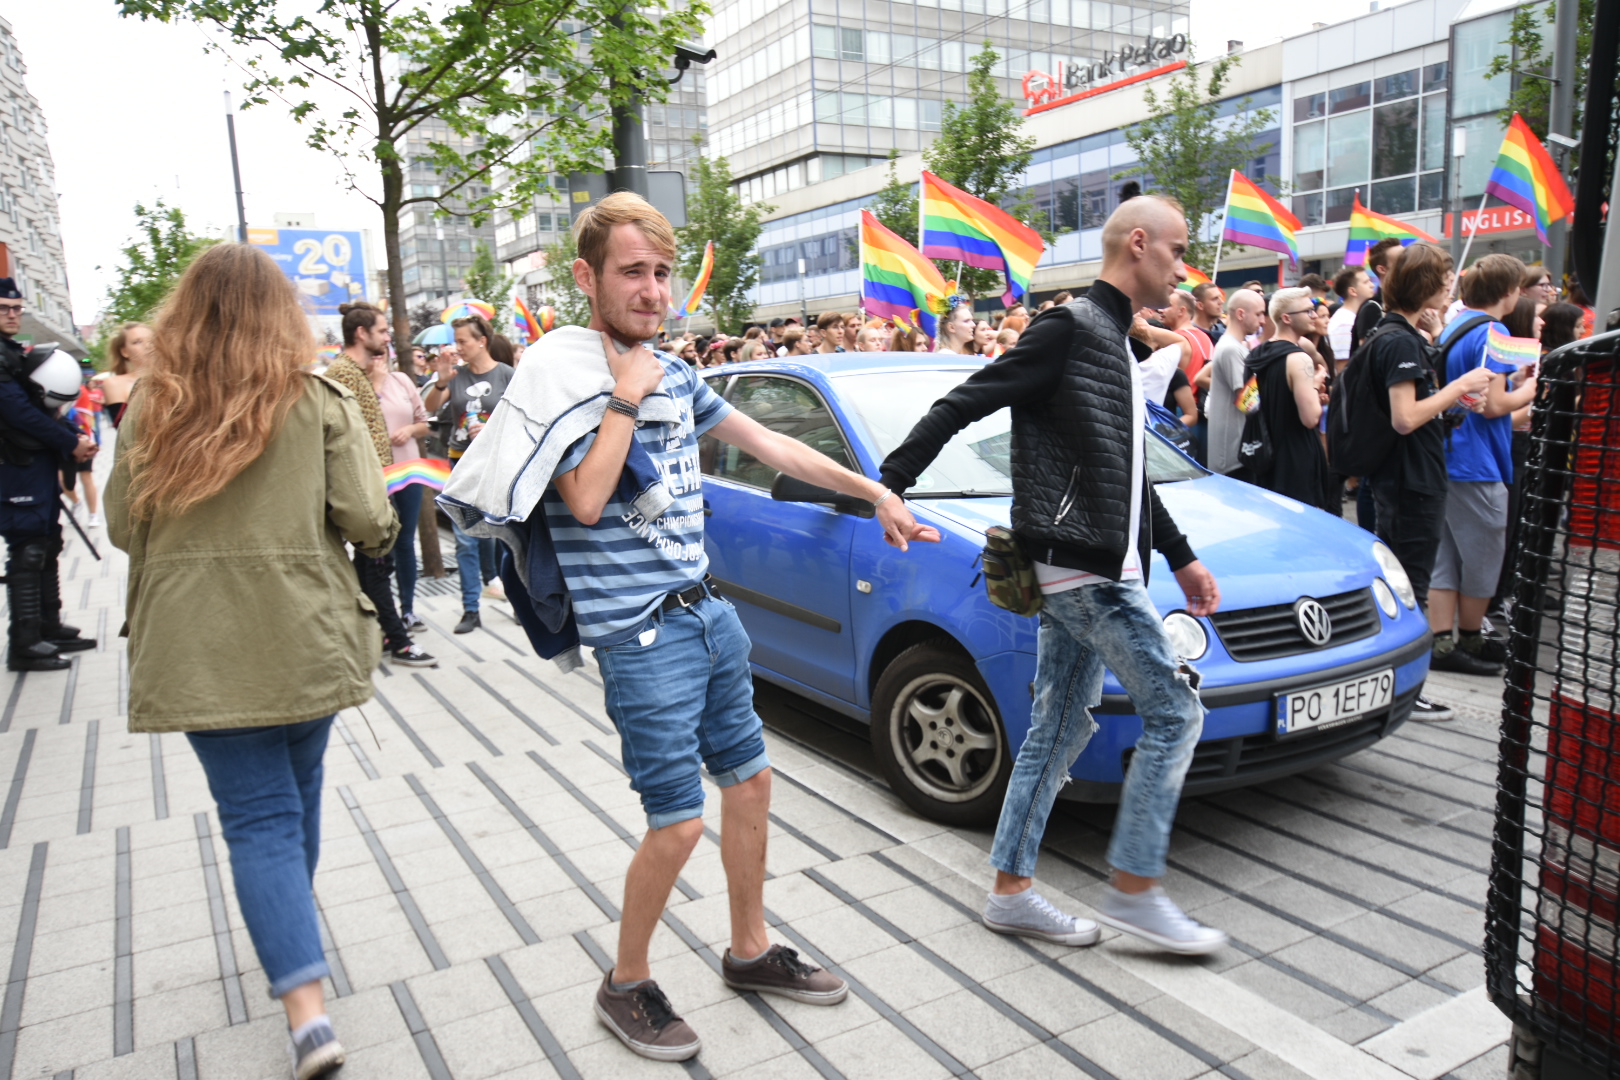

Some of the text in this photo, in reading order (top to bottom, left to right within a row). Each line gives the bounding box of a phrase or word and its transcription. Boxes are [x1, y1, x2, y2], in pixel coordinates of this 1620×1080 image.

[1066, 33, 1187, 89] Bank Pekao
[1453, 209, 1533, 232] NGLIS
[293, 233, 352, 275] 20
[1291, 691, 1322, 728] PO
[1332, 674, 1391, 717] 1EF79
[1277, 718, 1286, 729] PL
